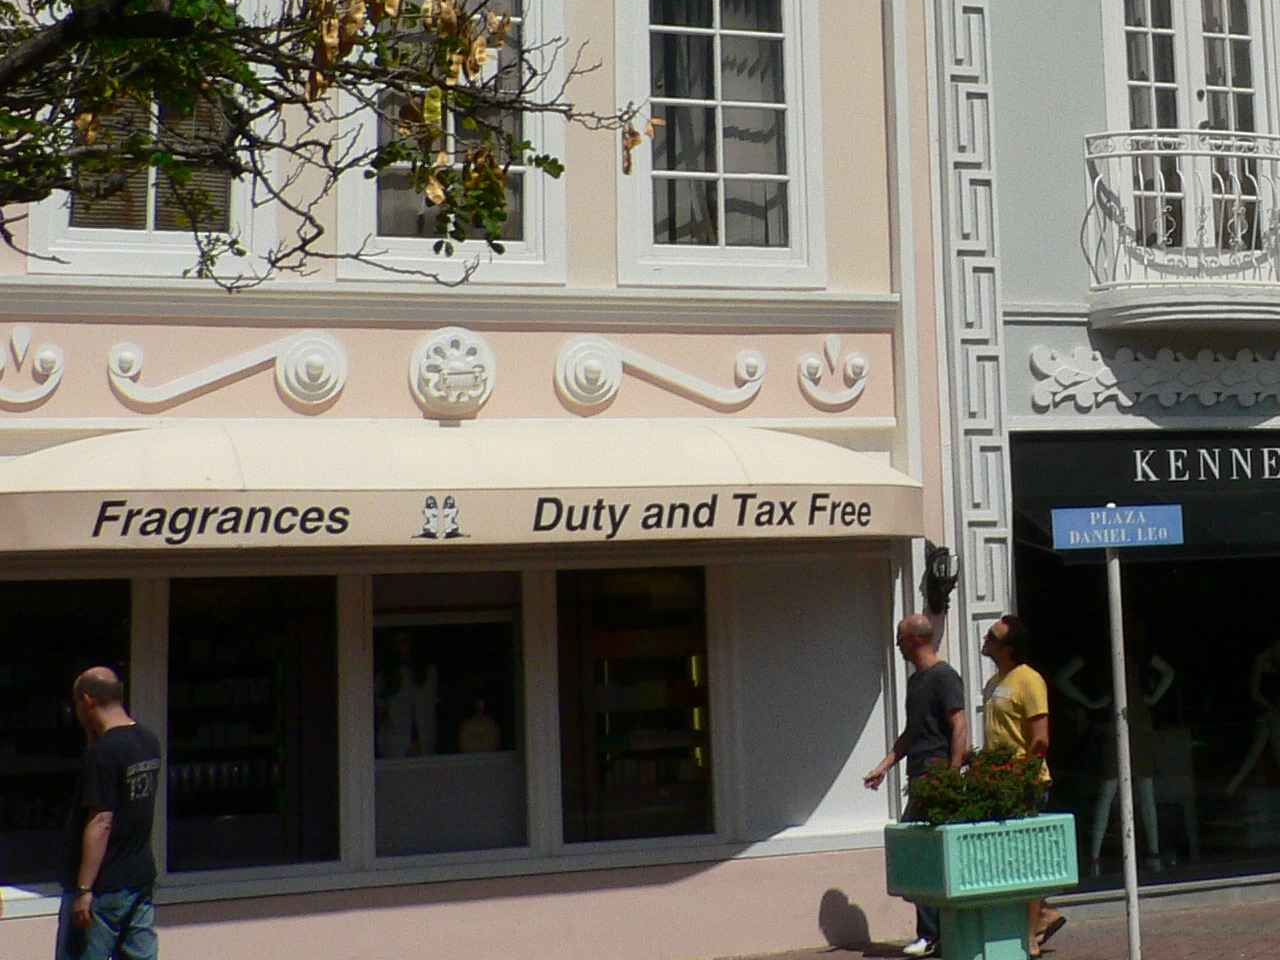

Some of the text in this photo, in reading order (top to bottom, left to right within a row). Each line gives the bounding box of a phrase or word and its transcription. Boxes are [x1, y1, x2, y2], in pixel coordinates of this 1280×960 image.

[92, 500, 350, 545] Fragrances
[532, 493, 872, 540] Duty and Tax Free
[1089, 511, 1146, 525] PLAZA
[1070, 527, 1168, 544] DANIEL LEO
